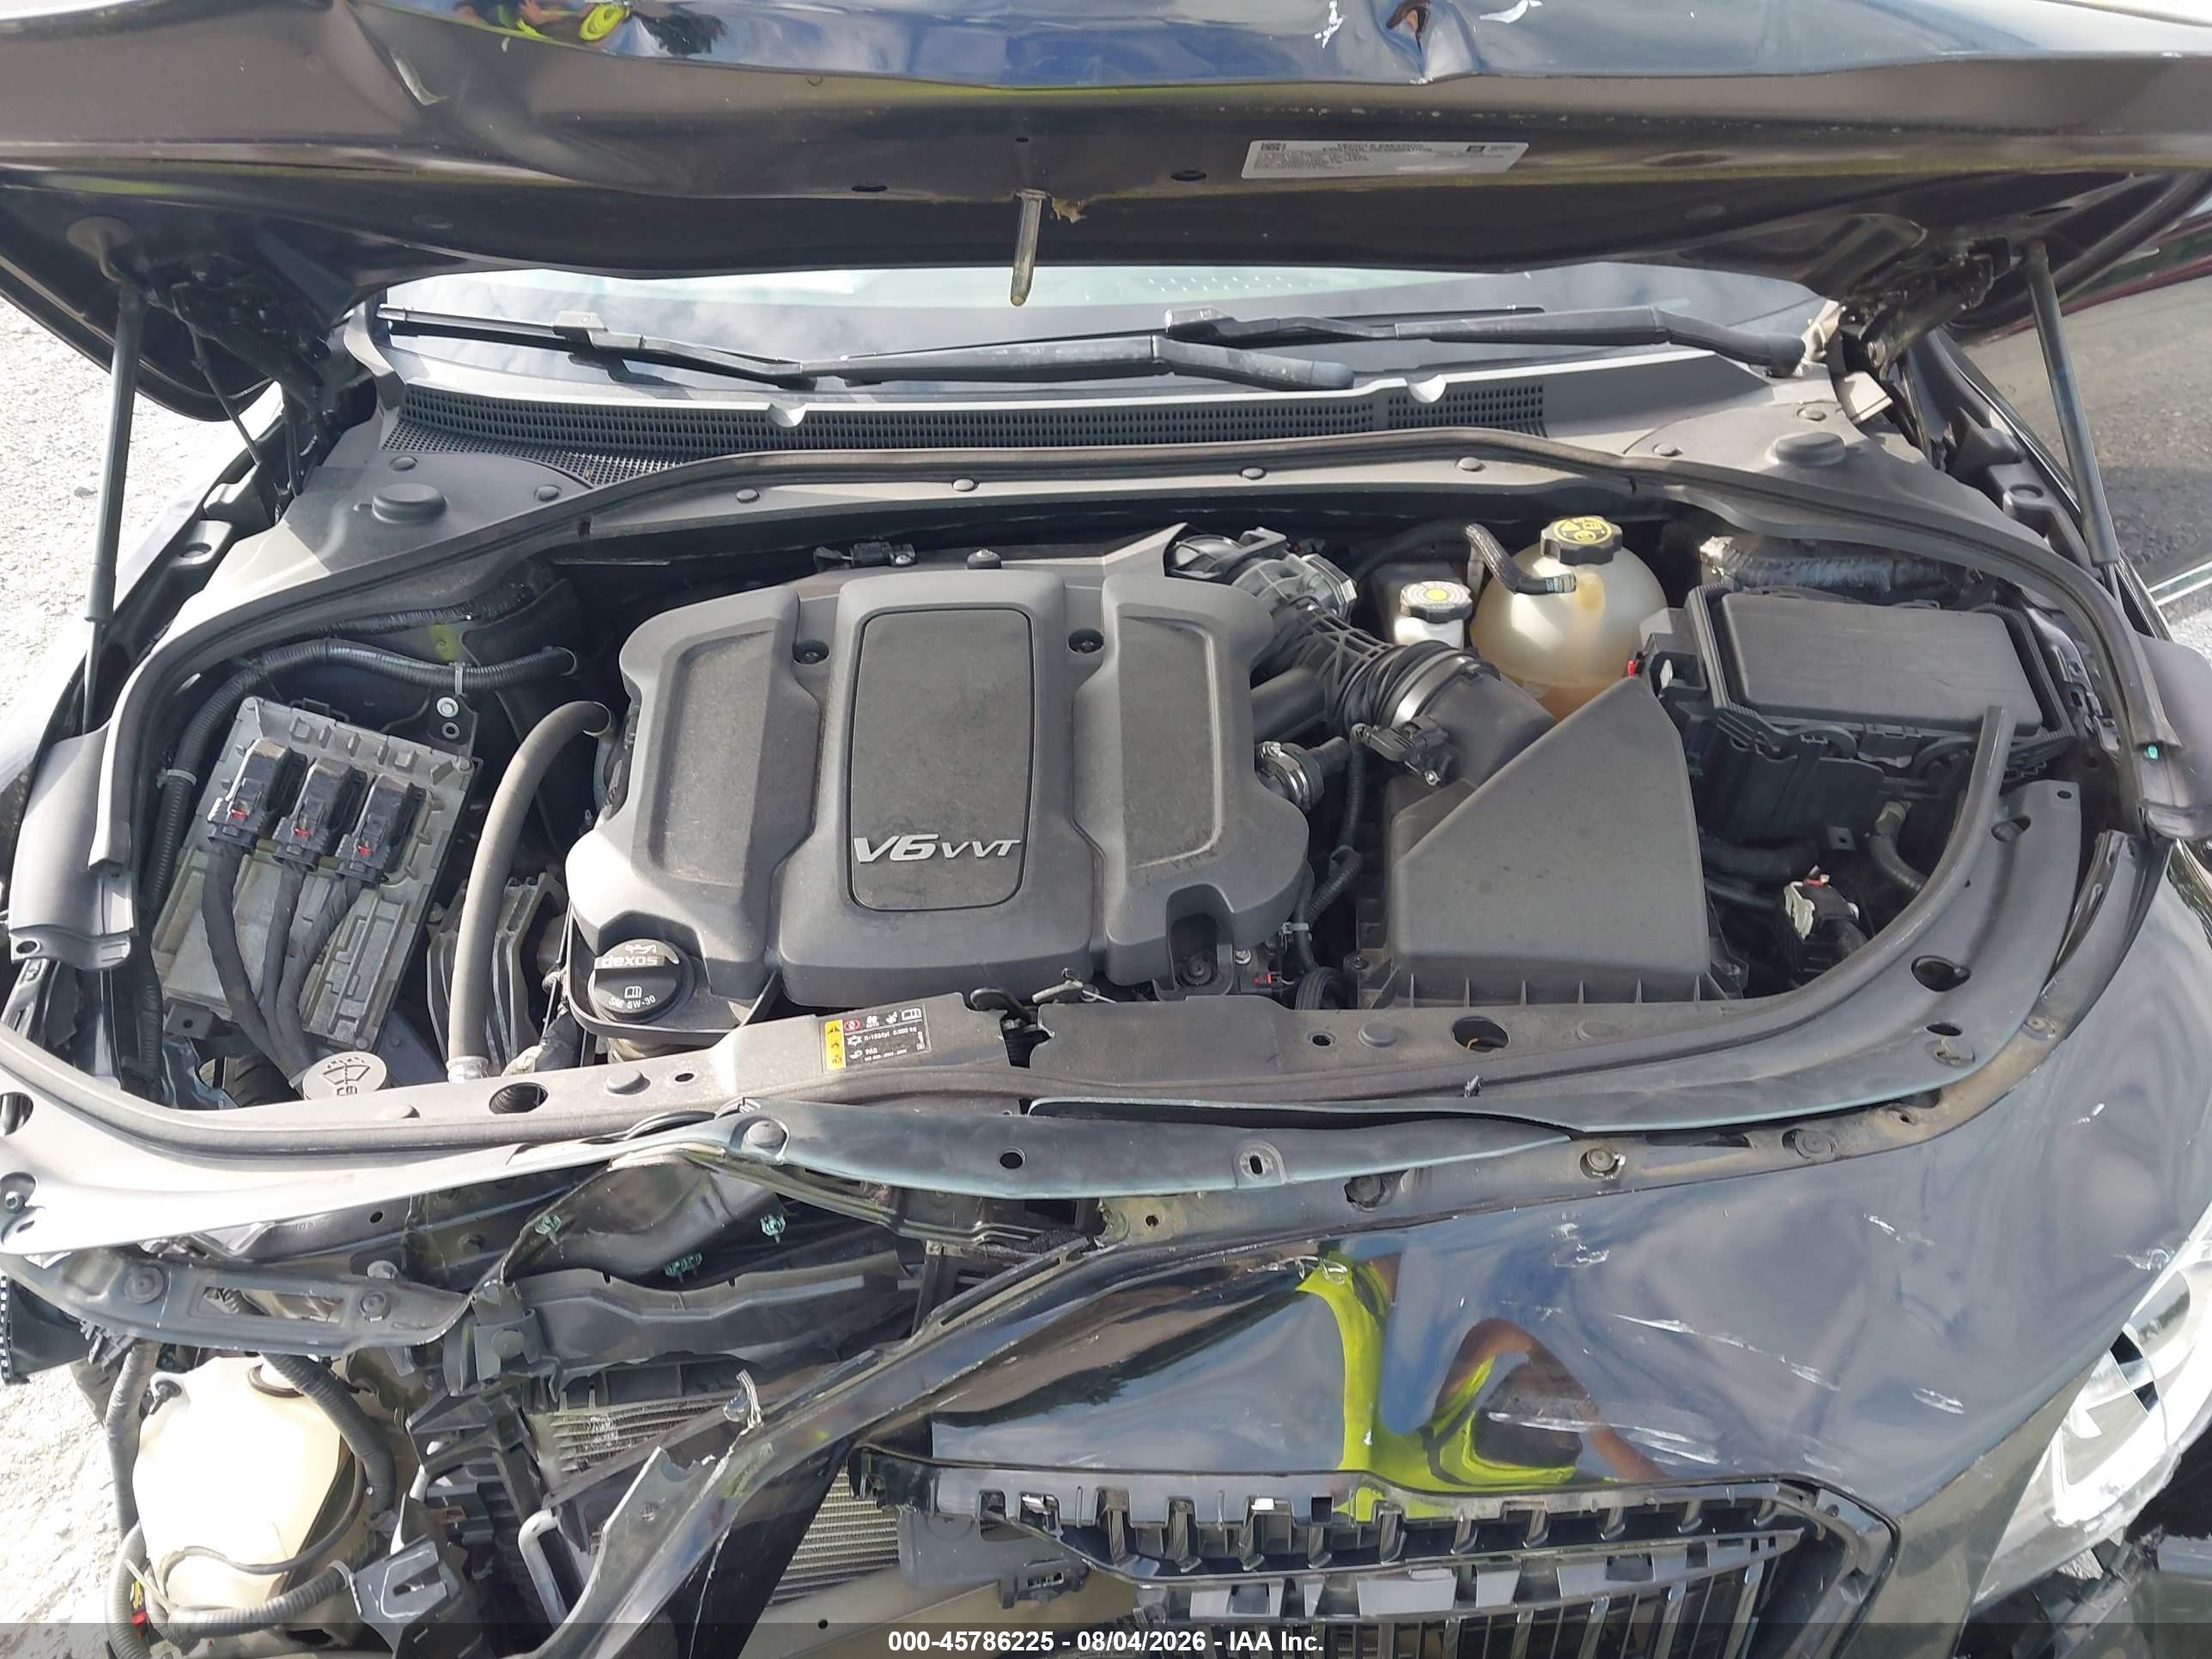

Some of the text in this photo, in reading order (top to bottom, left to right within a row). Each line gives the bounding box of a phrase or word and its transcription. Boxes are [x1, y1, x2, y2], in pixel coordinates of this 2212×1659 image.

[854, 833, 1021, 863] V6 VVT
[601, 955, 658, 968] dexos
[608, 996, 625, 1009] SAE
